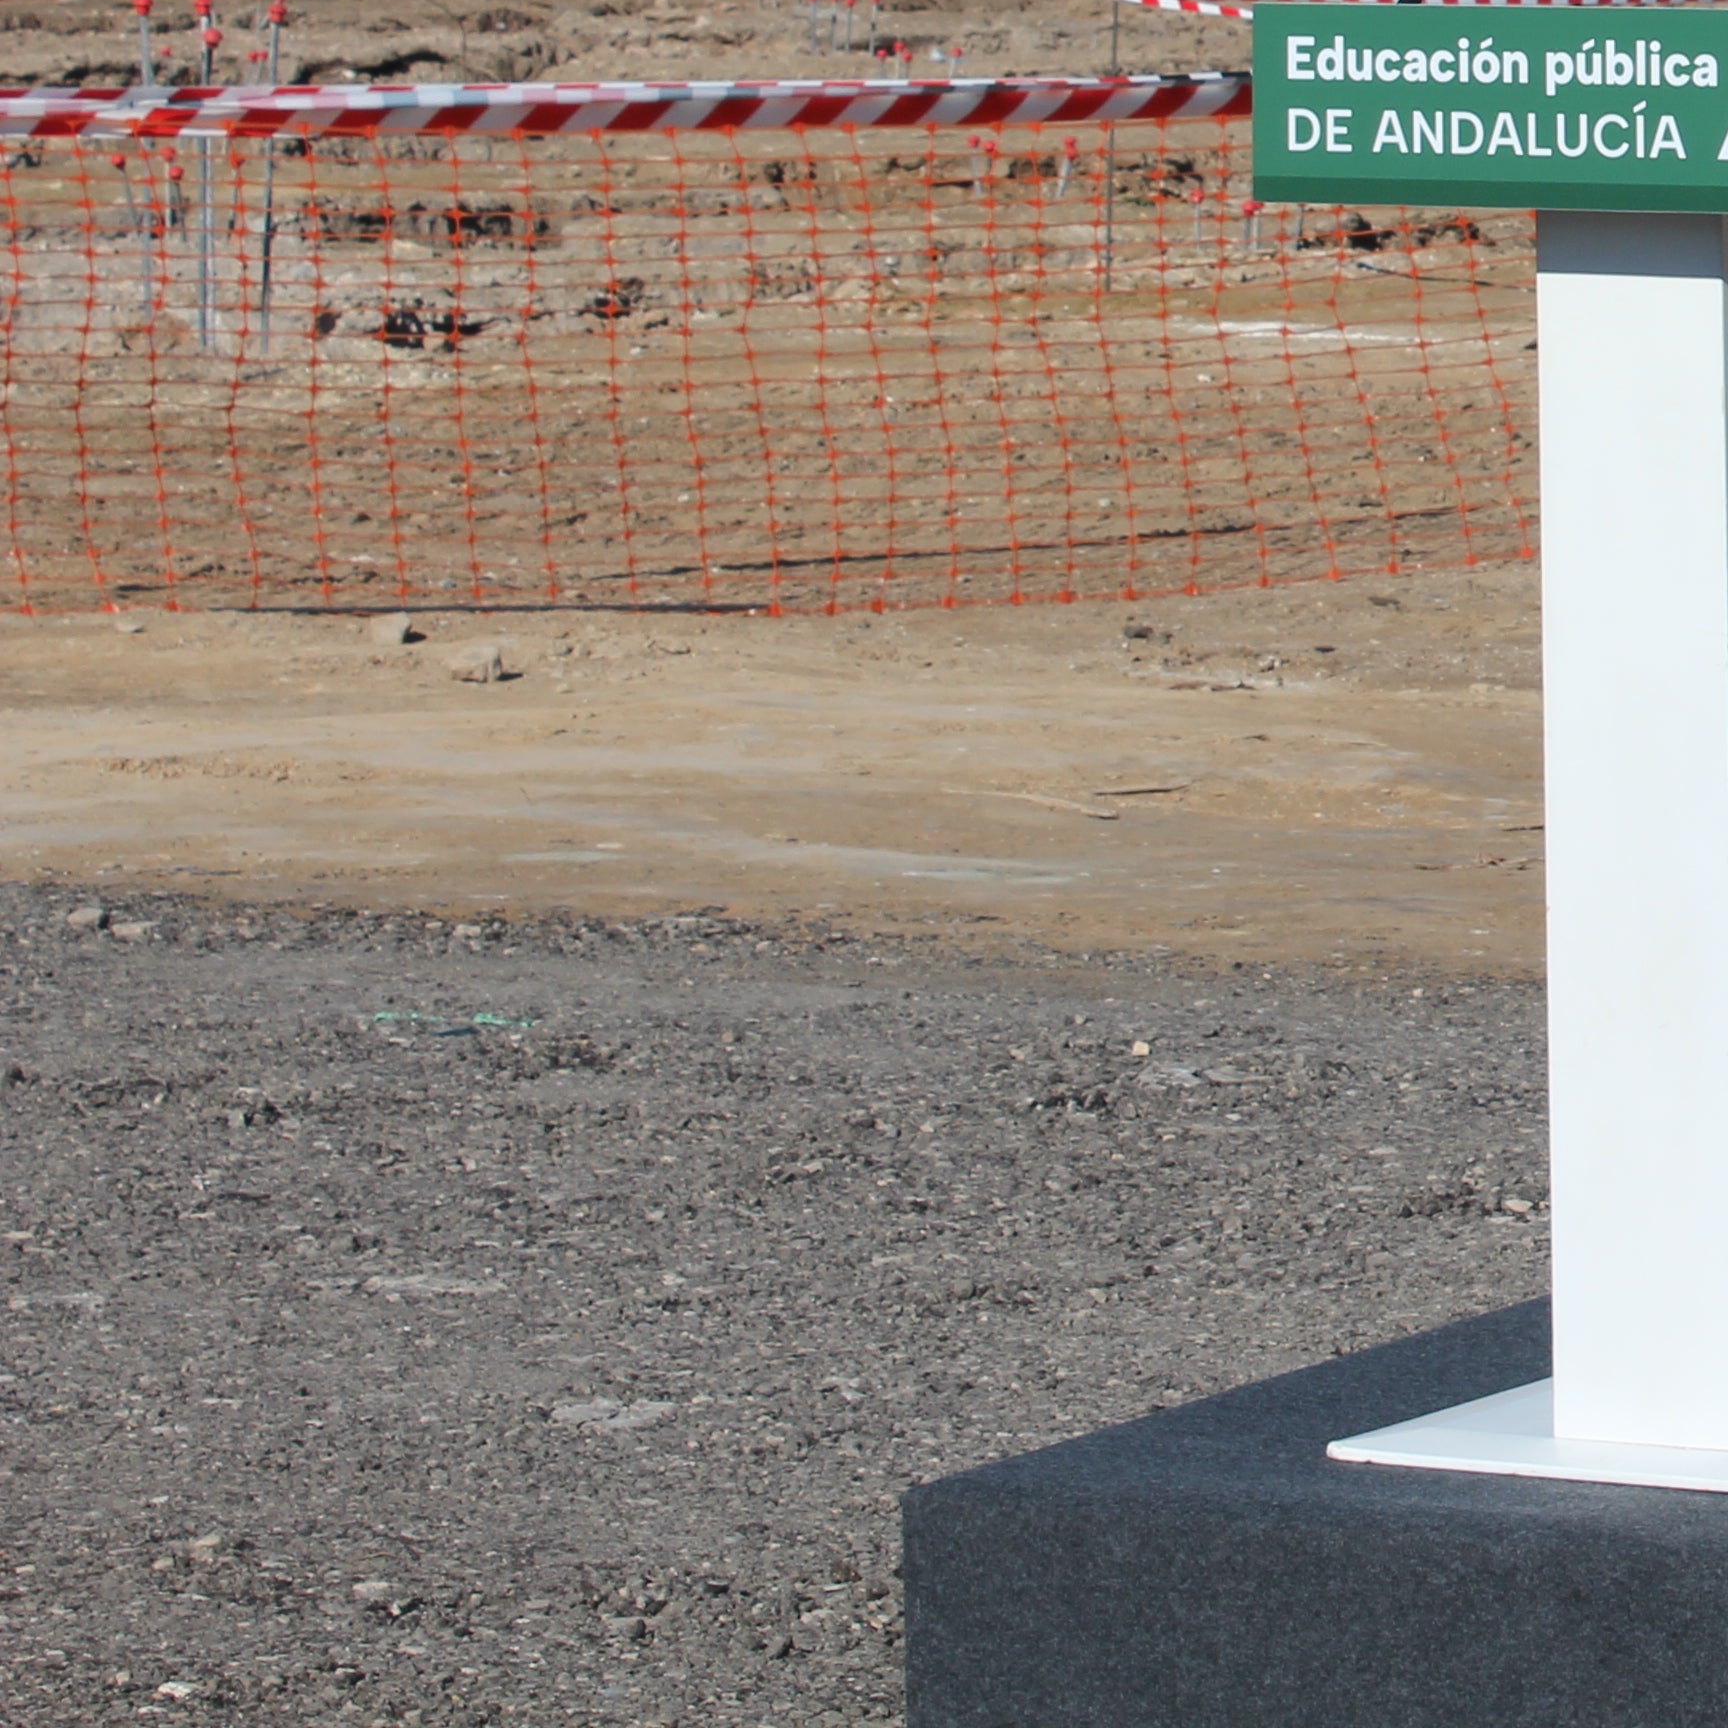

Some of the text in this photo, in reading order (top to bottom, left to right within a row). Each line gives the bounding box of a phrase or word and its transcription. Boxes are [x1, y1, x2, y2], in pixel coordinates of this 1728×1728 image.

[1286, 35, 1719, 97] Educación pública
[1286, 101, 1687, 160] DE ANDALUCÍA
